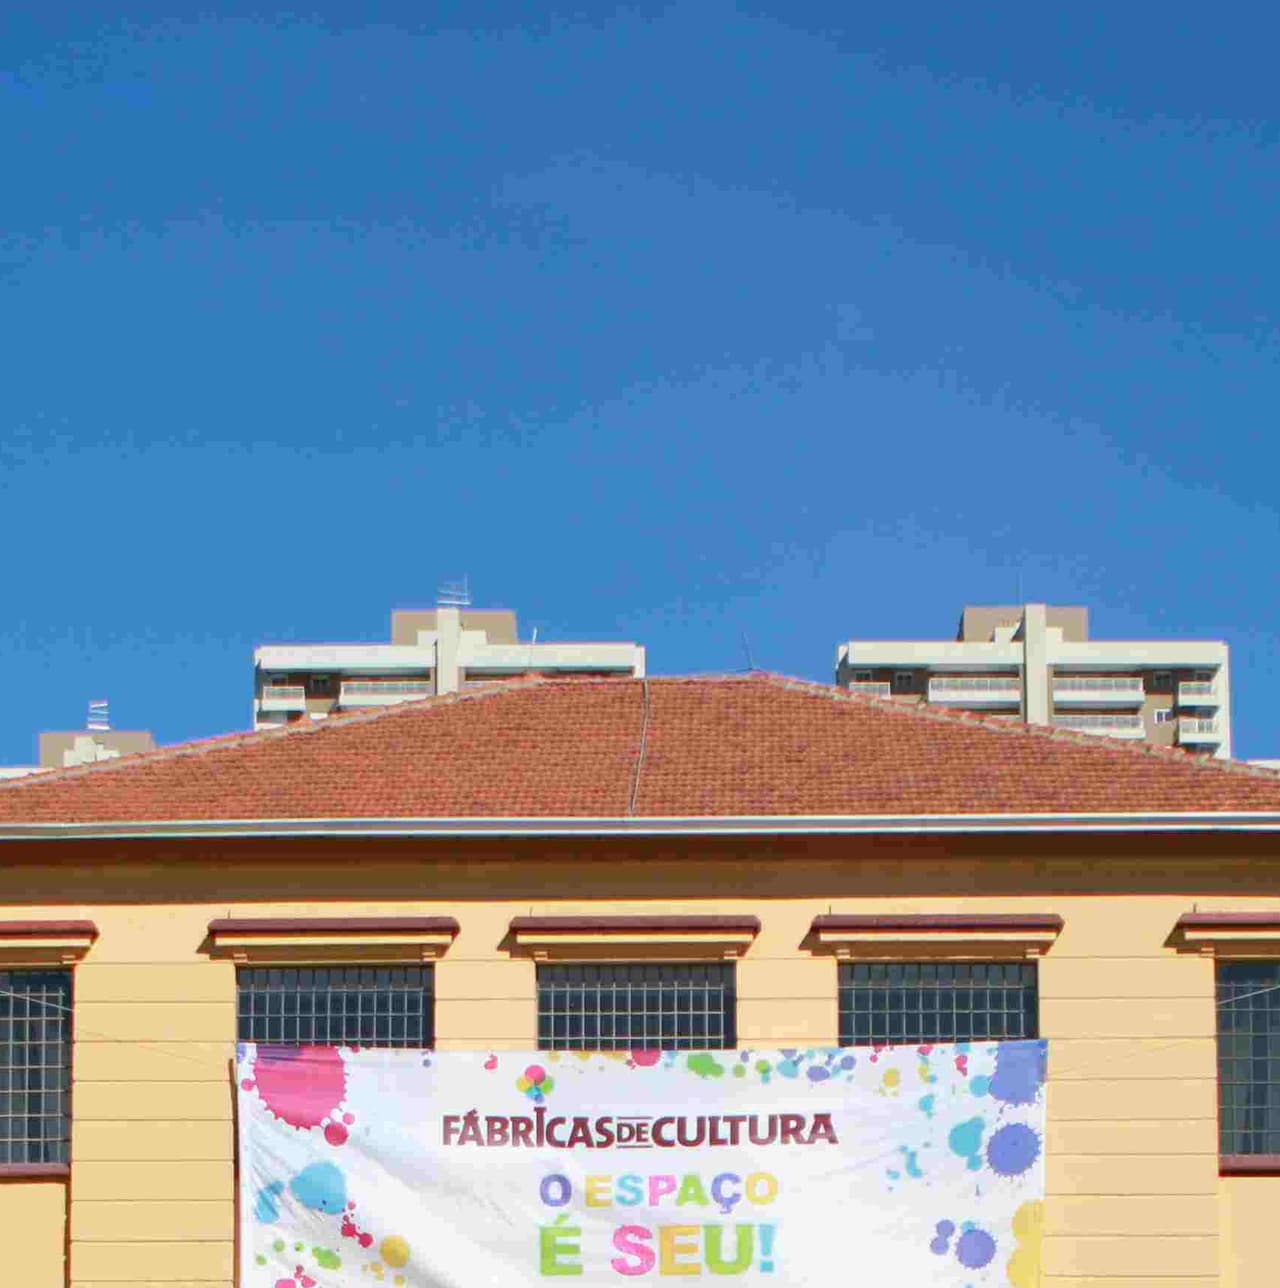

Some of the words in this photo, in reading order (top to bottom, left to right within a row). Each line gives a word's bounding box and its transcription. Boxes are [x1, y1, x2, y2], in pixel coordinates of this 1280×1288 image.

[539, 1173, 572, 1207] O
[584, 1171, 779, 1214] ESPAÇO
[538, 1212, 583, 1277] É
[611, 1222, 776, 1276] SEU!
